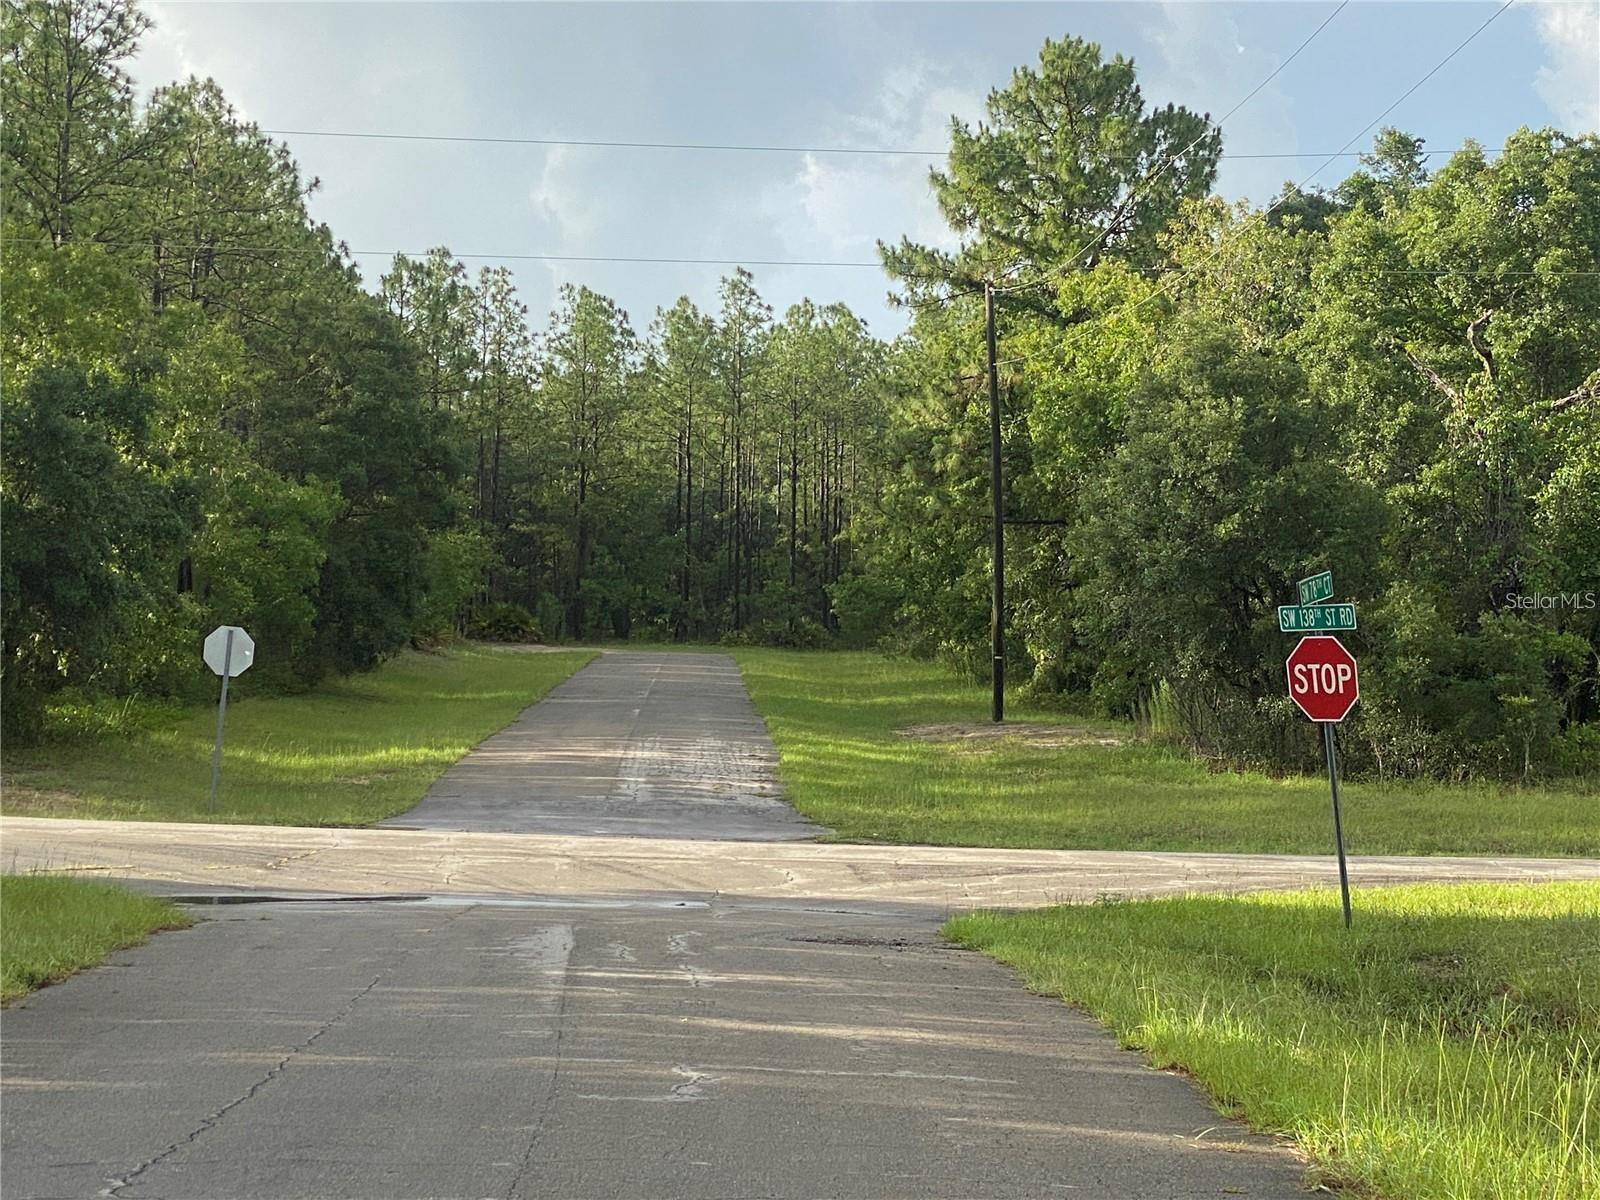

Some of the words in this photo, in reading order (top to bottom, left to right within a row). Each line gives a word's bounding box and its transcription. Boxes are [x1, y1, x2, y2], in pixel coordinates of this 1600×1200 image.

[1302, 583, 1309, 603] SW
[1323, 575, 1331, 595] CT
[1282, 609, 1296, 627] SW
[1299, 608, 1322, 627] 138TH
[1325, 608, 1336, 626] ST
[1339, 607, 1353, 626] RD
[1293, 663, 1352, 694] STOP
